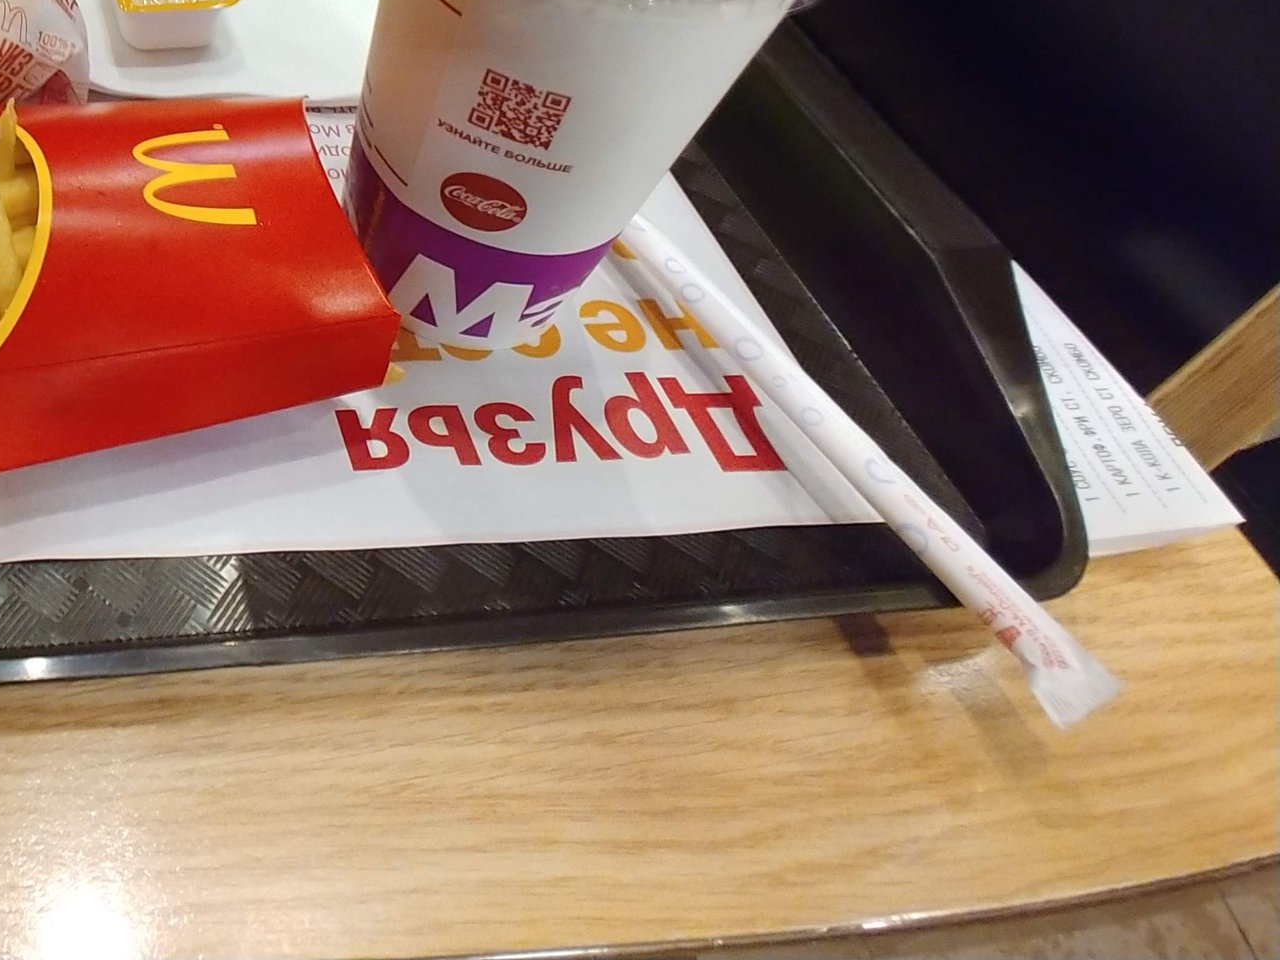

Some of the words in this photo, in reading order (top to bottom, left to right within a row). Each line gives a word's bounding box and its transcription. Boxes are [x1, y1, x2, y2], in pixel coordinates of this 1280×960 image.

[436, 118, 501, 155] УЗНАЙТЕ
[504, 150, 574, 173] БОЛЬШЕ
[444, 185, 525, 220] Coca-Cola
[579, 298, 720, 353] Не
[1063, 343, 1100, 380] СКОМБО
[1094, 388, 1114, 400] СТ
[335, 372, 789, 472] Друзья
[1107, 405, 1137, 433] ЗЕРО
[1131, 439, 1173, 481] К-КОЛА
